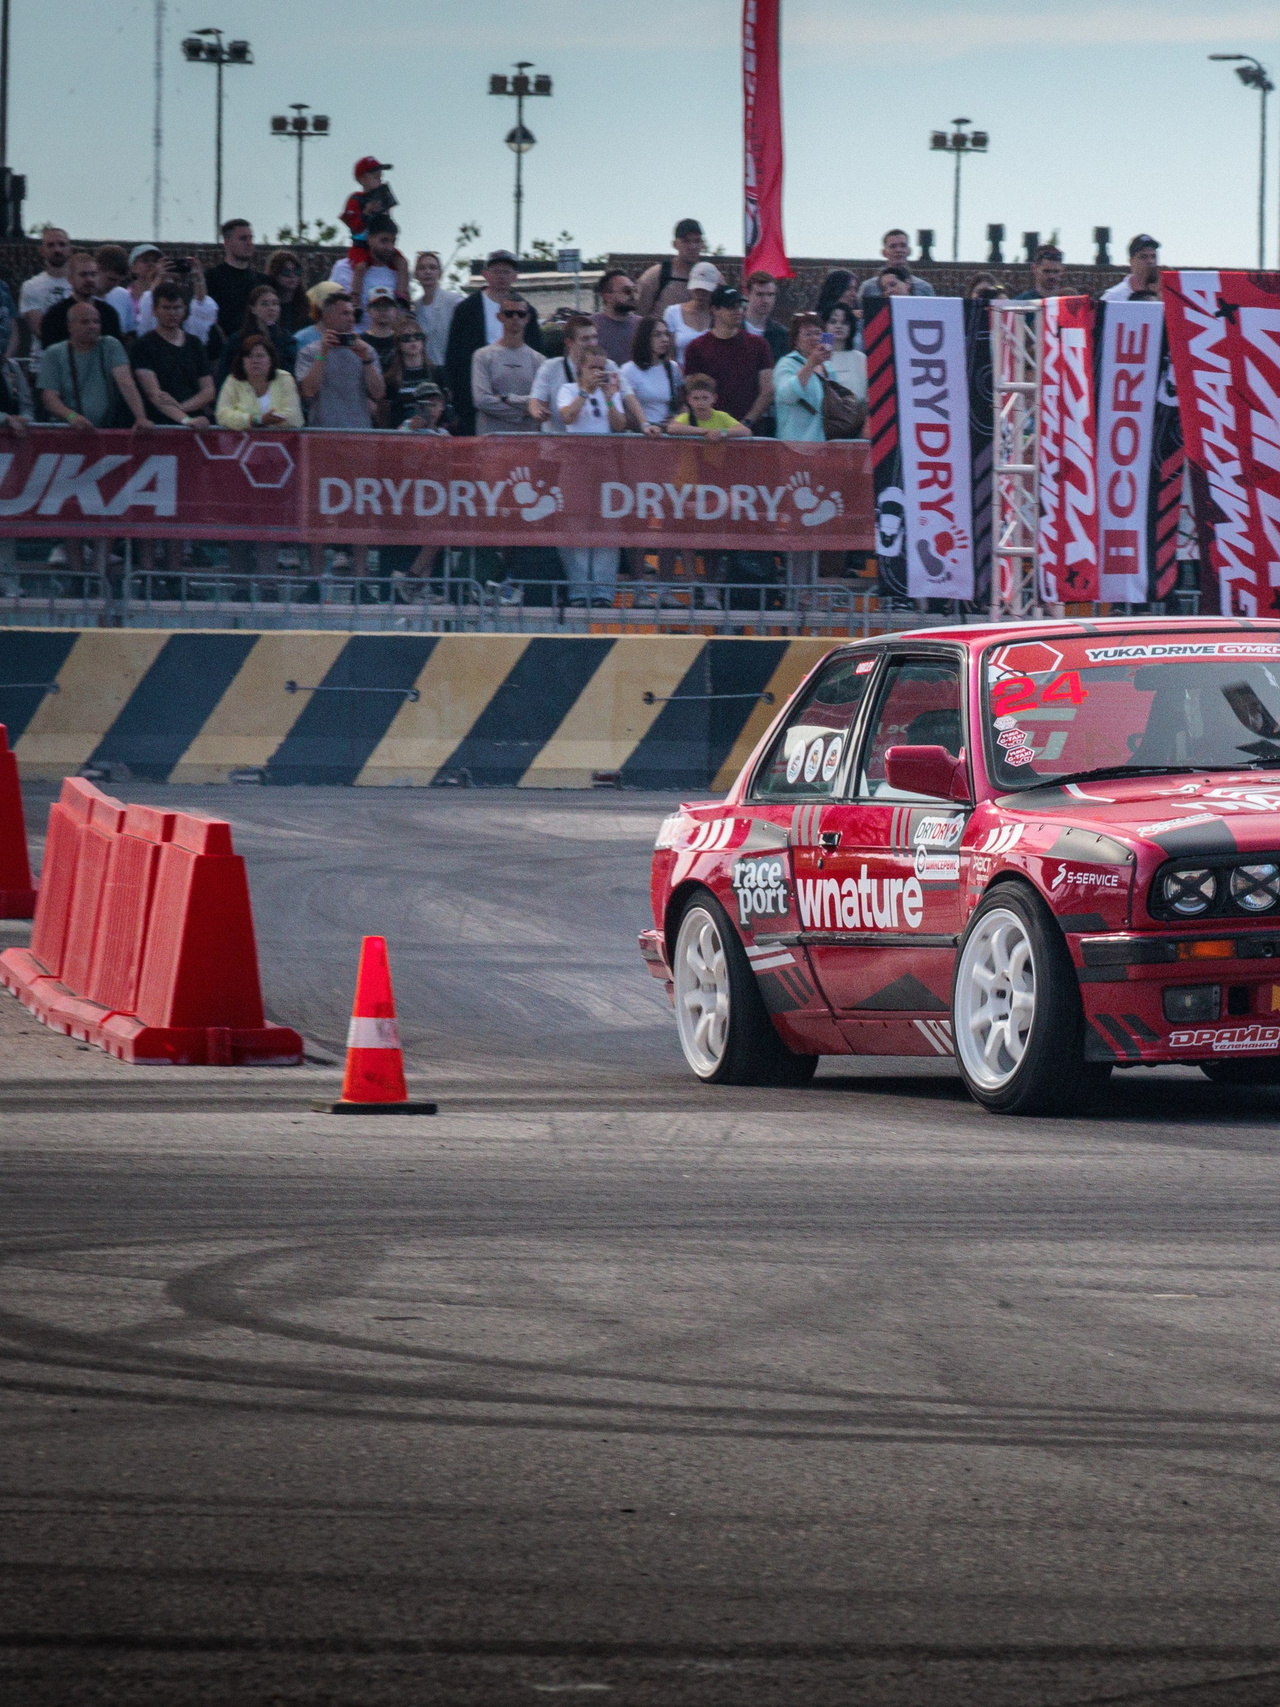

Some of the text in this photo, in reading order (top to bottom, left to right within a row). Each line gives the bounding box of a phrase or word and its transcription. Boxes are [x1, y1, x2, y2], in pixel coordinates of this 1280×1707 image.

[906, 319, 955, 524] DRYDRY
[1061, 328, 1097, 565] YUKA
[1179, 271, 1258, 617] GYMKHANA
[318, 477, 508, 517] DRYDRY
[600, 481, 788, 522] DRYDRY
[1089, 647, 1147, 660] YUKA
[1151, 645, 1216, 656] DRIVE
[993, 671, 1089, 717] 24
[916, 822, 952, 840] DRYDRY
[733, 862, 783, 889] race
[1066, 871, 1119, 887] S-SERVICE
[737, 884, 788, 925] port
[796, 864, 924, 929] wnature
